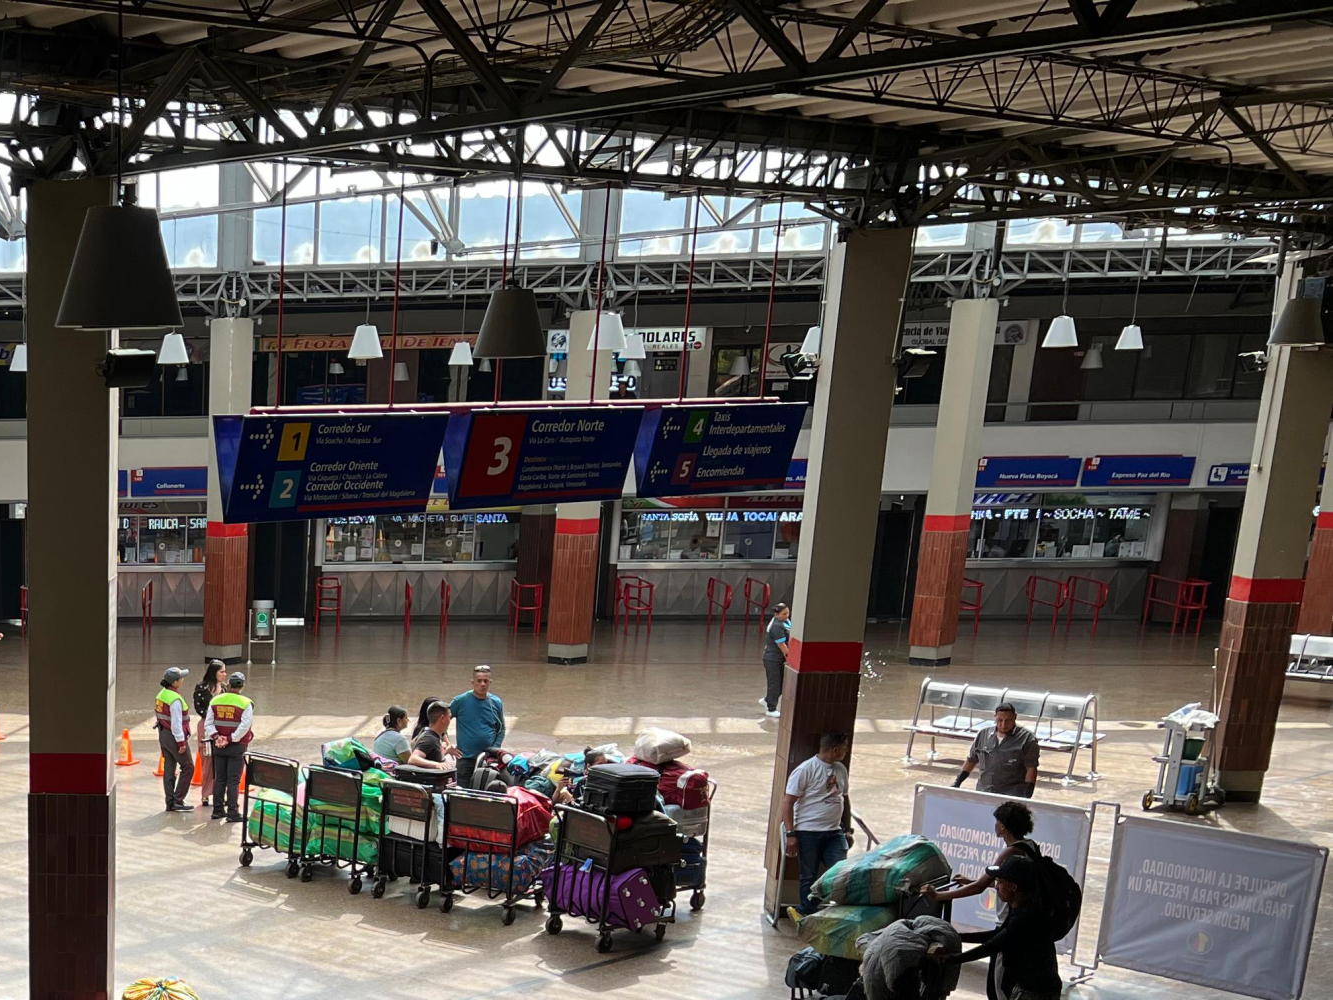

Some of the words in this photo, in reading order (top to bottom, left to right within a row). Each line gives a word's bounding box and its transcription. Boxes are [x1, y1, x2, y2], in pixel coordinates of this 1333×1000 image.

[924, 327, 934, 335] de
[531, 419, 575, 433] Corredor
[577, 419, 604, 432] Norte
[692, 418, 705, 436] 4
[714, 411, 732, 422] Taxis
[709, 421, 786, 437] Interdepartamentales
[292, 431, 302, 451] 1
[318, 423, 355, 435] Corredor
[356, 422, 372, 433] Sur
[487, 436, 512, 476] 3
[702, 445, 732, 459] Llegada
[733, 444, 742, 455] de
[743, 443, 772, 457] viajeros
[310, 462, 347, 473] Corredor
[348, 460, 379, 471] Oriente
[679, 460, 692, 478] 5
[696, 465, 745, 478] Encomiendas
[1112, 472, 1136, 480] Expreso
[279, 479, 295, 499] 2
[306, 481, 343, 493] Corredor
[344, 480, 384, 492] Occidente
[476, 513, 508, 523] SANTA
[1053, 508, 1094, 520] SOCHA
[148, 518, 179, 530] RAUCA
